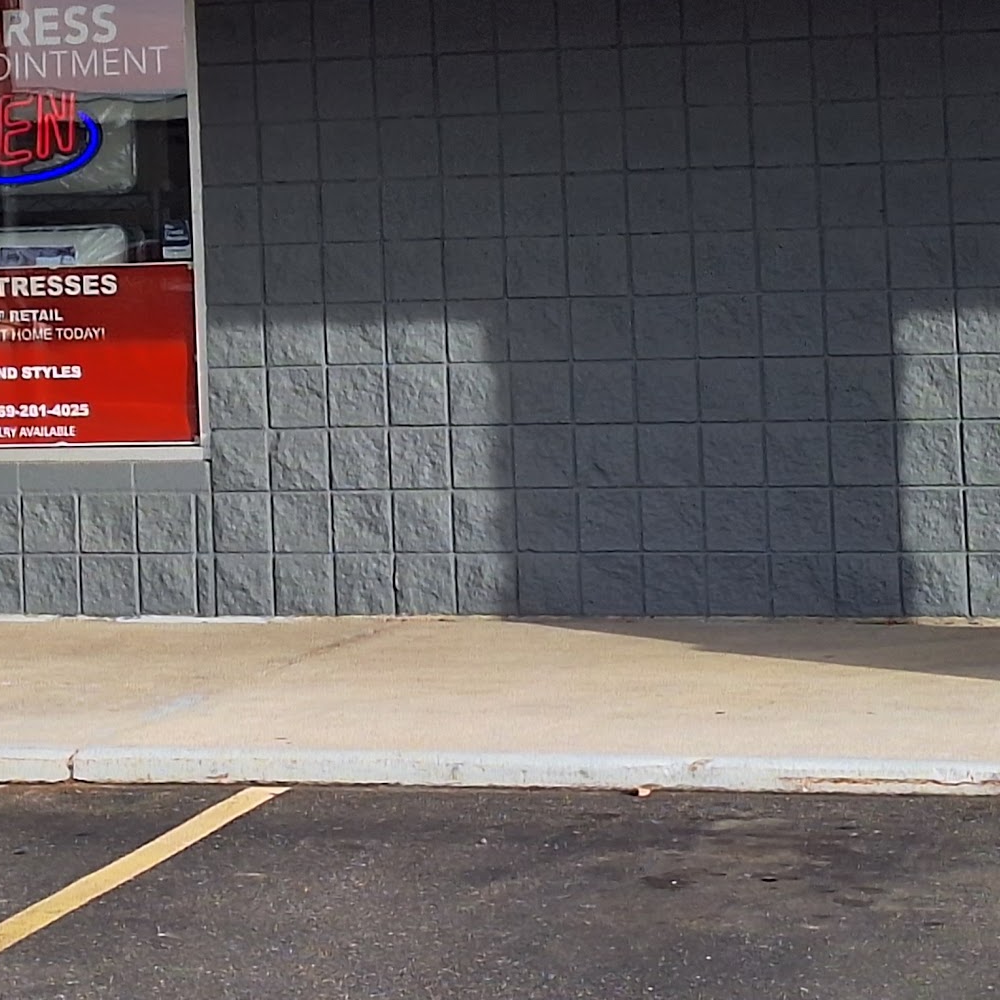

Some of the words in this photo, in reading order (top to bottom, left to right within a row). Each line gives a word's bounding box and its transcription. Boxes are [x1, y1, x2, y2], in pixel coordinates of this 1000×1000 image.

[9, 308, 64, 323] RETAIL
[11, 326, 53, 341] HOME
[55, 326, 106, 340] TODAY!
[21, 365, 82, 379] STYLES
[19, 425, 77, 437] AVAILABLE
